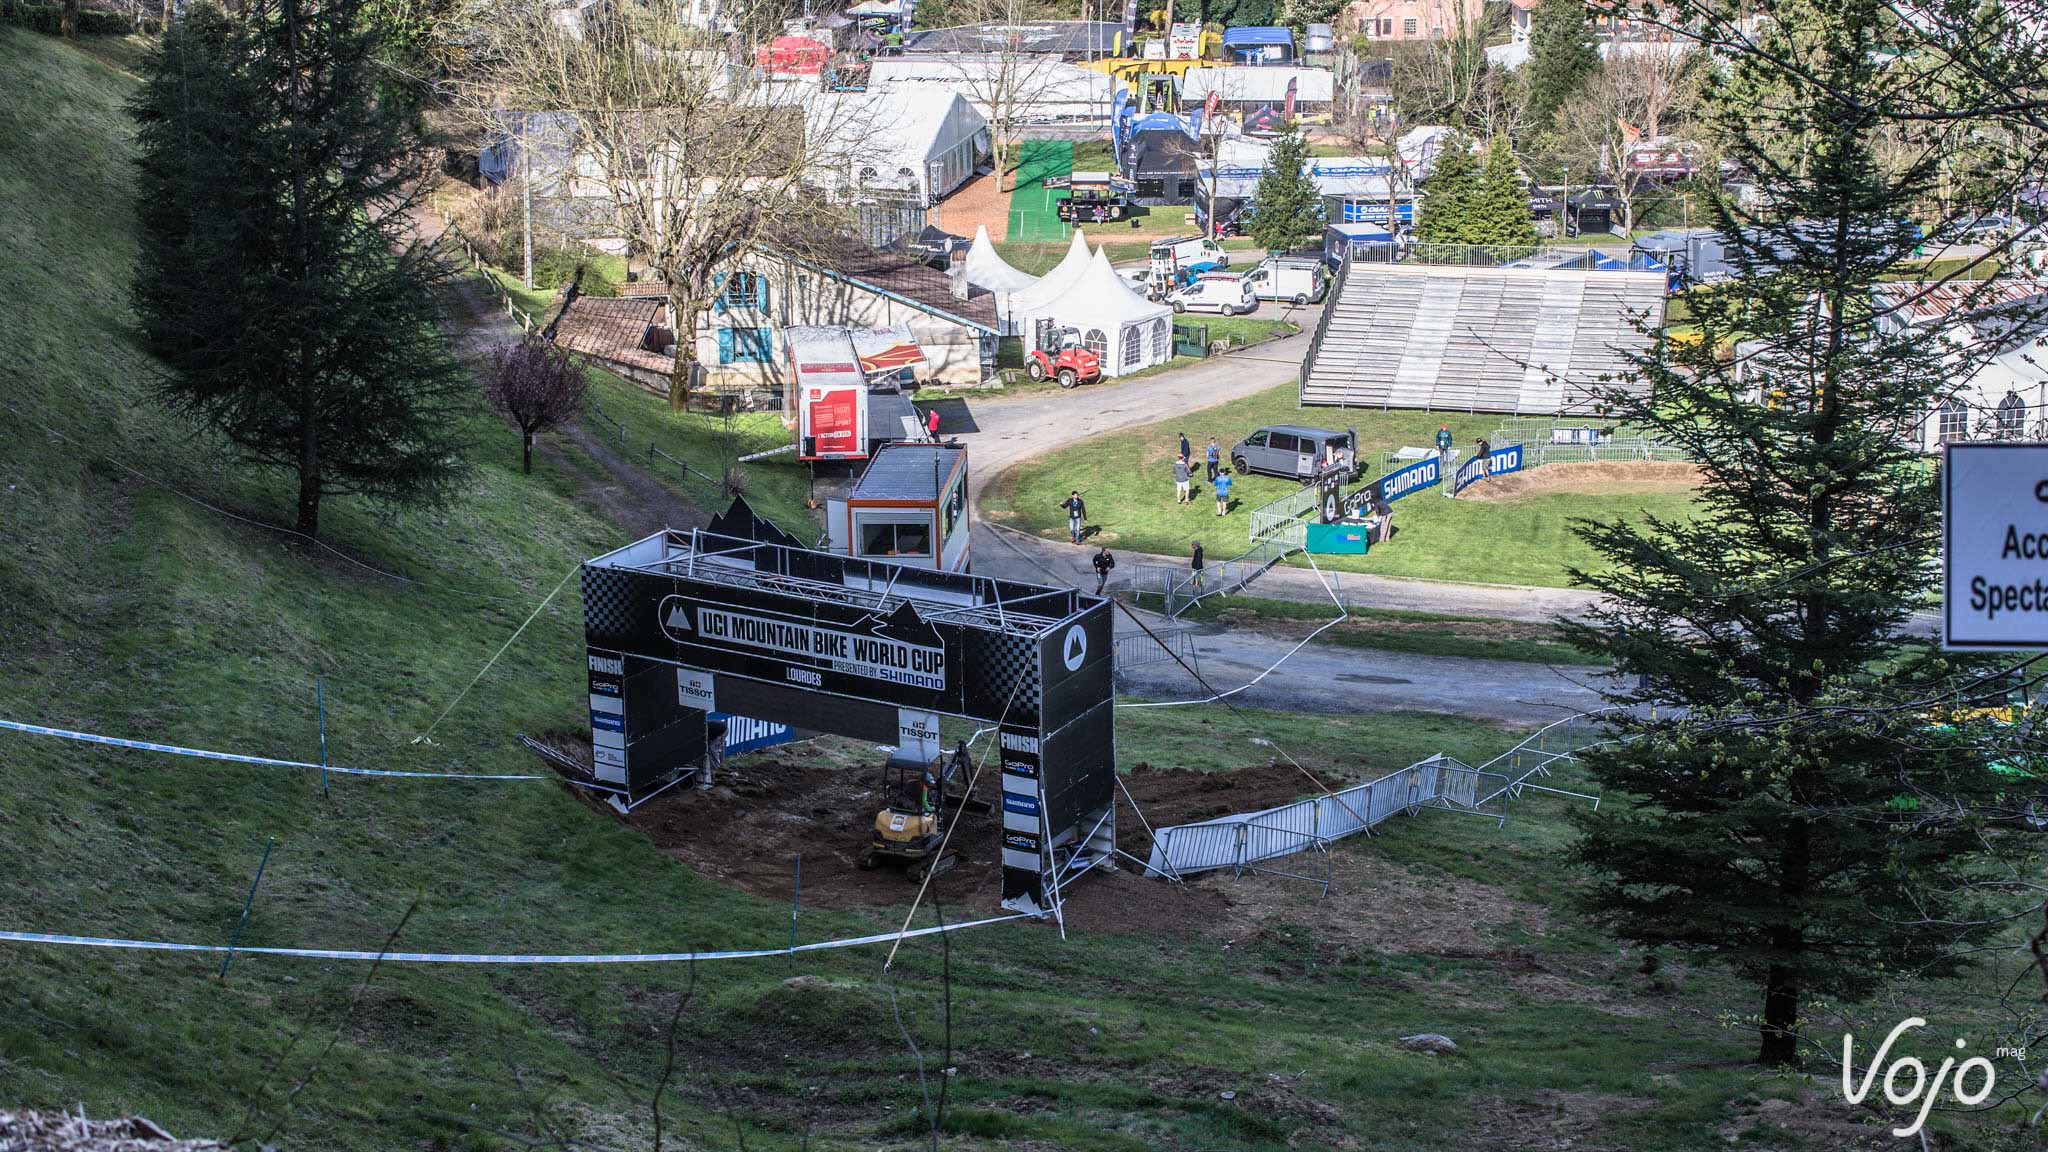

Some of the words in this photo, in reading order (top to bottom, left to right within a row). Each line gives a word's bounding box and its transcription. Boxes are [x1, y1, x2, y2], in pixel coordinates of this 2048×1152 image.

[1384, 463, 1436, 500] SHIMANO
[703, 611, 728, 638] UCI
[732, 617, 809, 652] MOUNTAIN
[814, 630, 847, 659] BIKE
[853, 637, 908, 669] WORLD
[912, 648, 944, 675] CUP
[588, 655, 624, 676] FINISH
[834, 660, 868, 676] PRESENTED
[870, 666, 877, 678] BY
[880, 668, 944, 690] SHIMANO
[786, 667, 822, 686] LOURDES
[680, 685, 713, 699] TISSOT
[900, 726, 938, 741] TISSOT
[1000, 731, 1039, 754] FINISH
[1004, 759, 1035, 770] GoPro
[1006, 833, 1037, 844] GoPro
